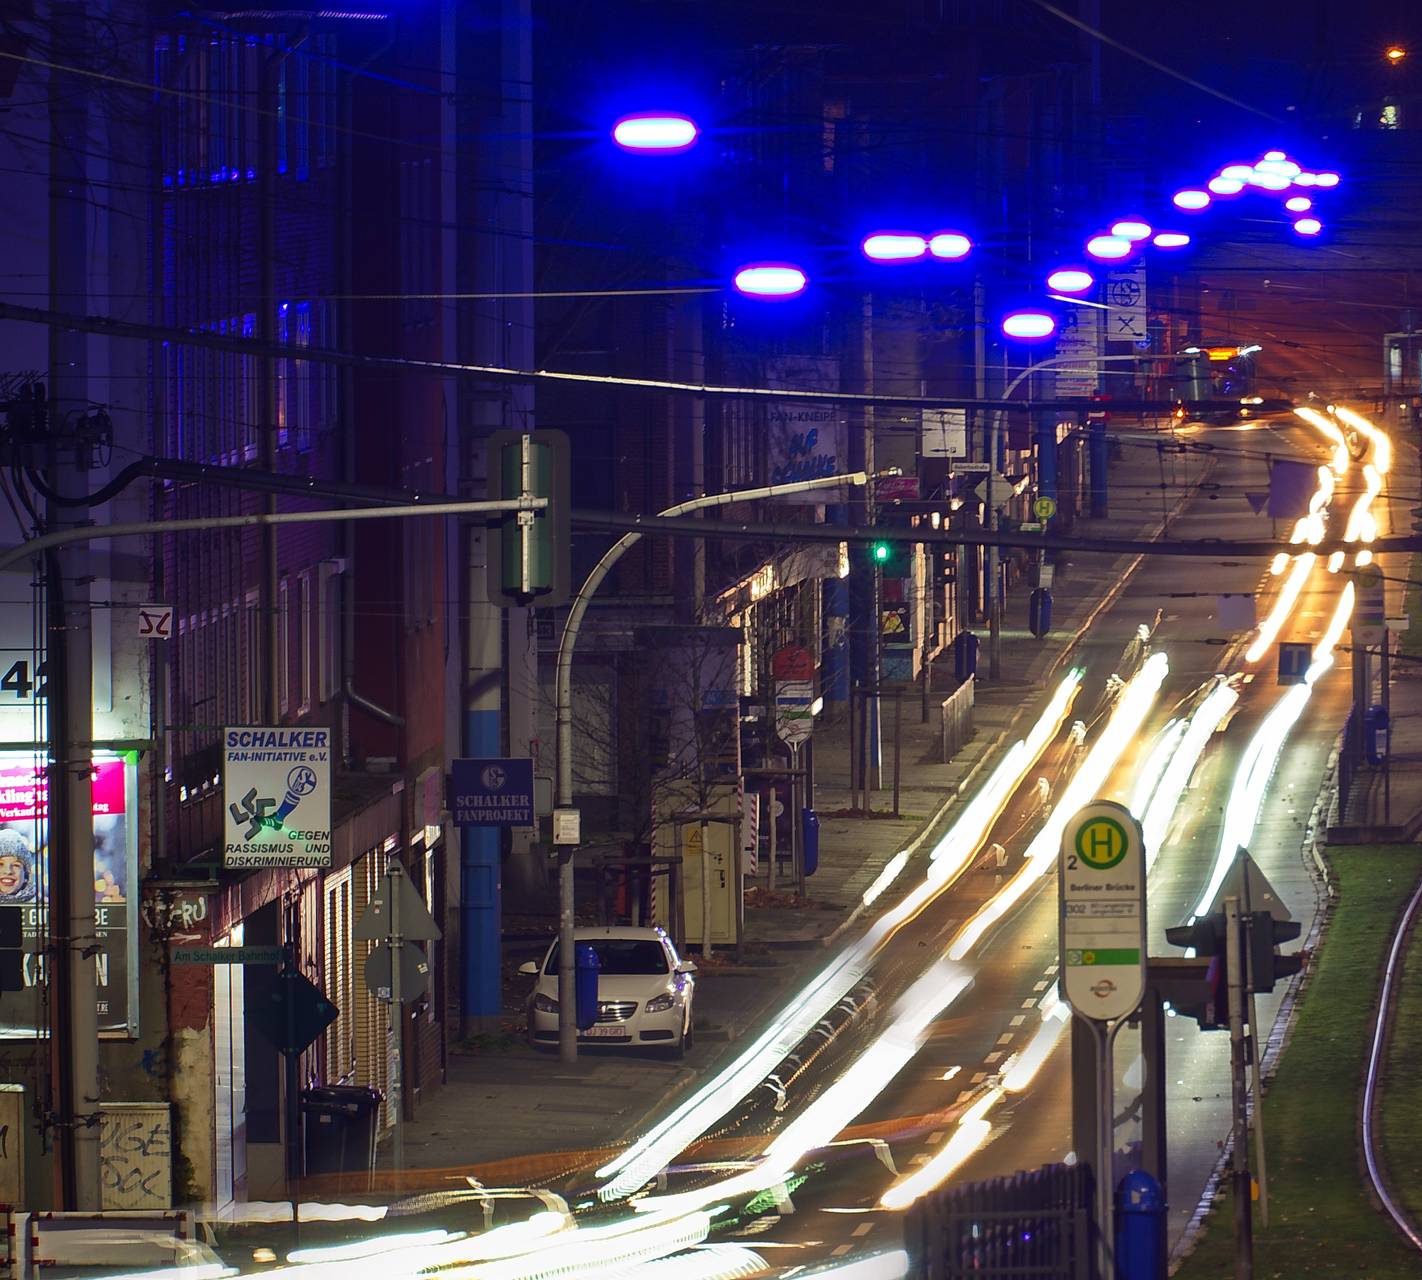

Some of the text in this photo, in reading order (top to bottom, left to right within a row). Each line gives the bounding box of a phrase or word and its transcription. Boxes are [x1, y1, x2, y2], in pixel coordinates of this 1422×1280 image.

[227, 731, 328, 748] SCHALKER
[227, 752, 328, 762] FAN-INITIATIVE e.V.
[456, 794, 530, 808] SCHALKER
[457, 809, 531, 821] FANPROJEKT
[288, 831, 330, 841] GEGEN
[1090, 827, 1113, 858] H
[226, 844, 330, 853] RASSISMUS UND
[226, 856, 330, 866] DISKRIMINIERUNG
[1067, 855, 1078, 870] 2
[175, 950, 280, 961] Am Schalker Bahnhof
